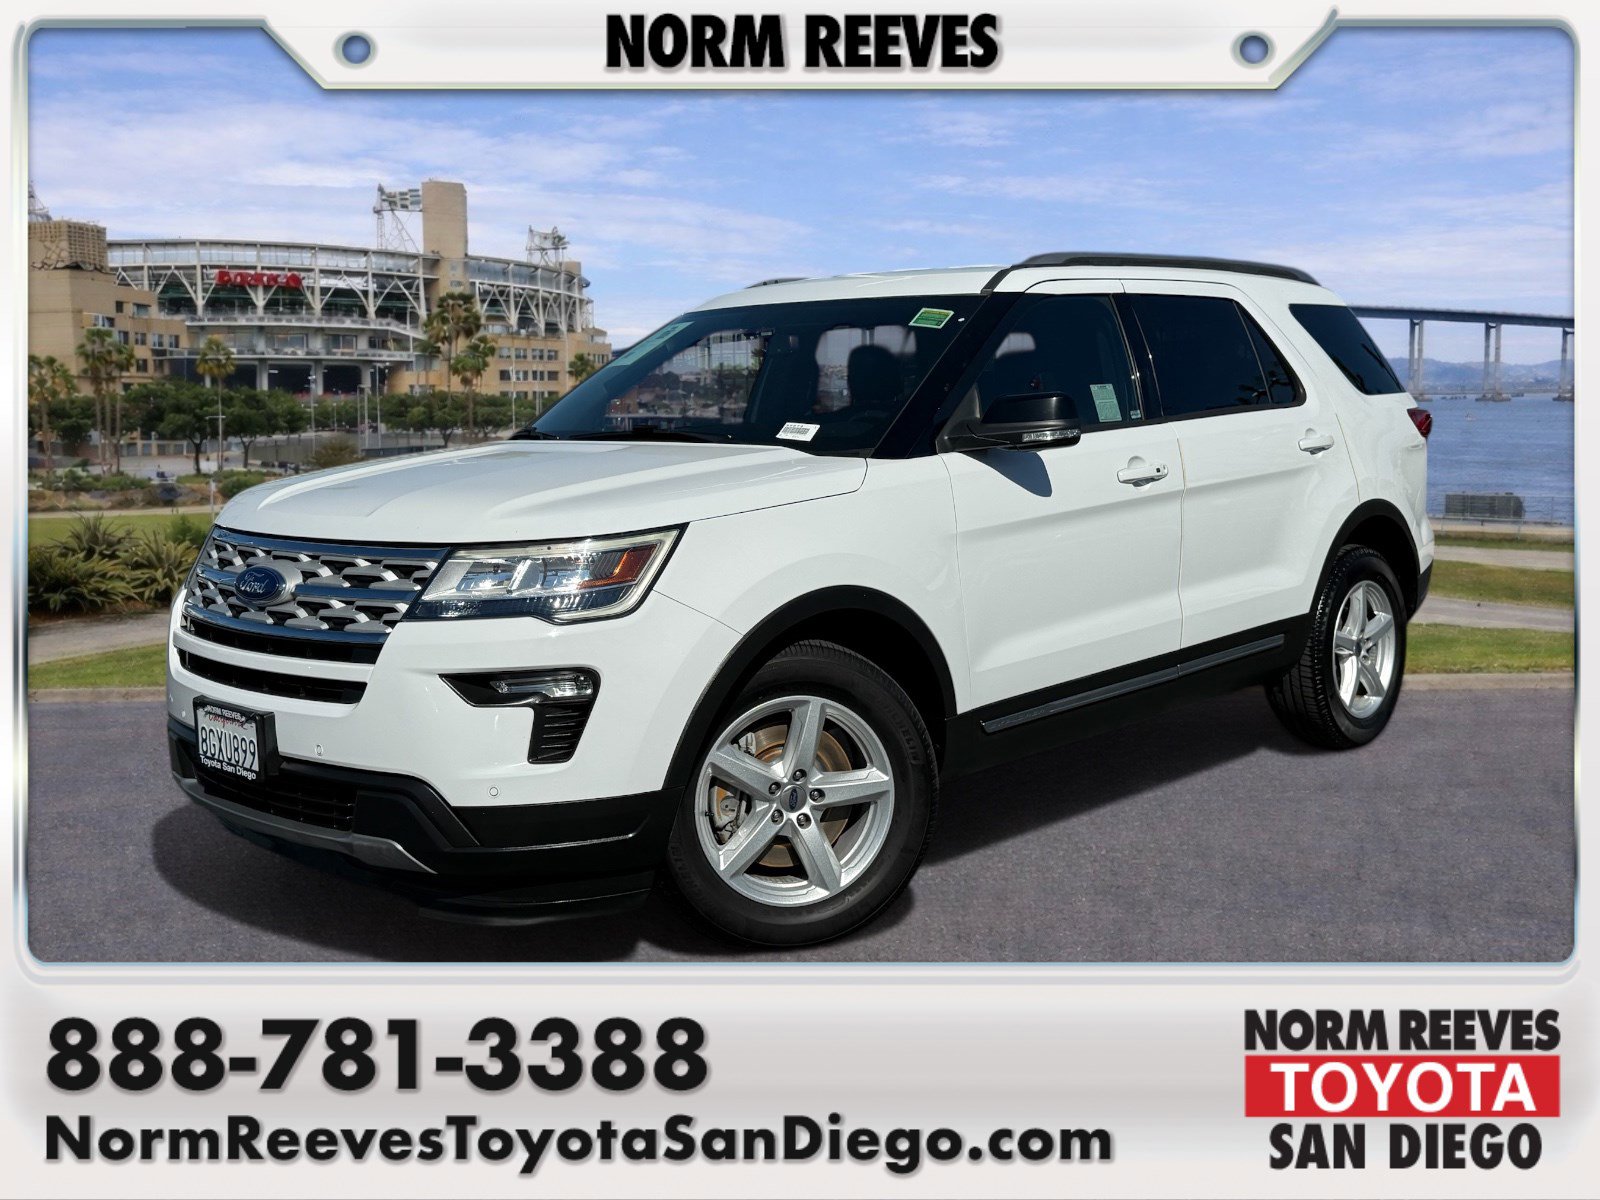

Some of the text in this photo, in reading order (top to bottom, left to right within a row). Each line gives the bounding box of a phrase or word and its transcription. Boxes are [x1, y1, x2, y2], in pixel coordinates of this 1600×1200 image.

[240, 572, 269, 593] Ford
[200, 726, 256, 770] 8GXU899
[200, 755, 256, 780] Toyota San Diego
